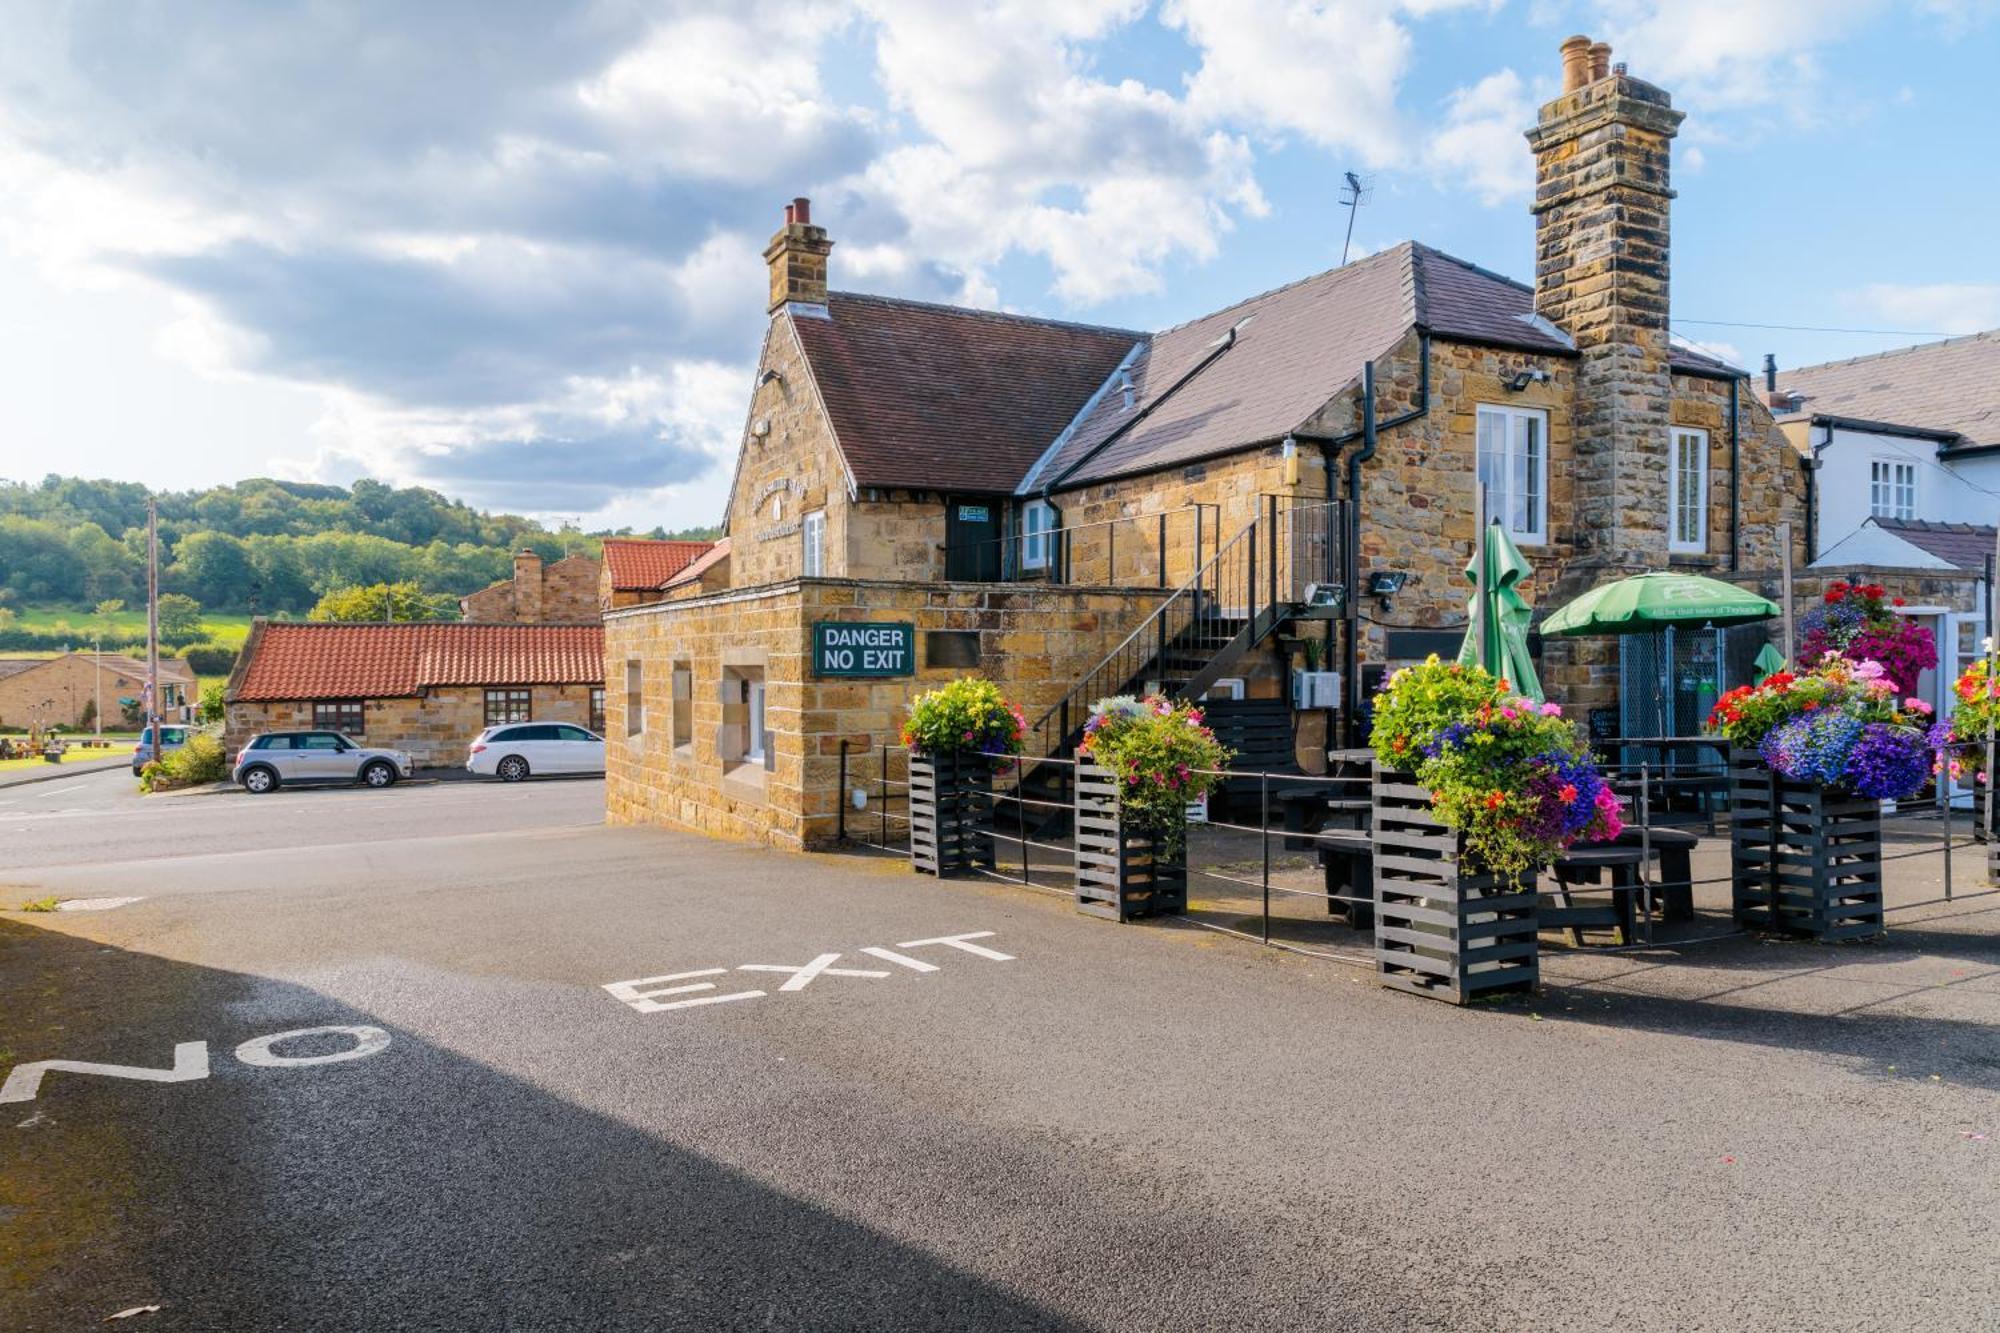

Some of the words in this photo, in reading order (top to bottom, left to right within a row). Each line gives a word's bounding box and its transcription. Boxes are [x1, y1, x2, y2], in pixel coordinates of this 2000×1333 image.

[825, 629, 904, 646] DANGER
[824, 649, 854, 669] NO
[863, 650, 905, 669] EXIT
[0, 1025, 392, 1103] NO
[602, 931, 1016, 1013] EXIT
